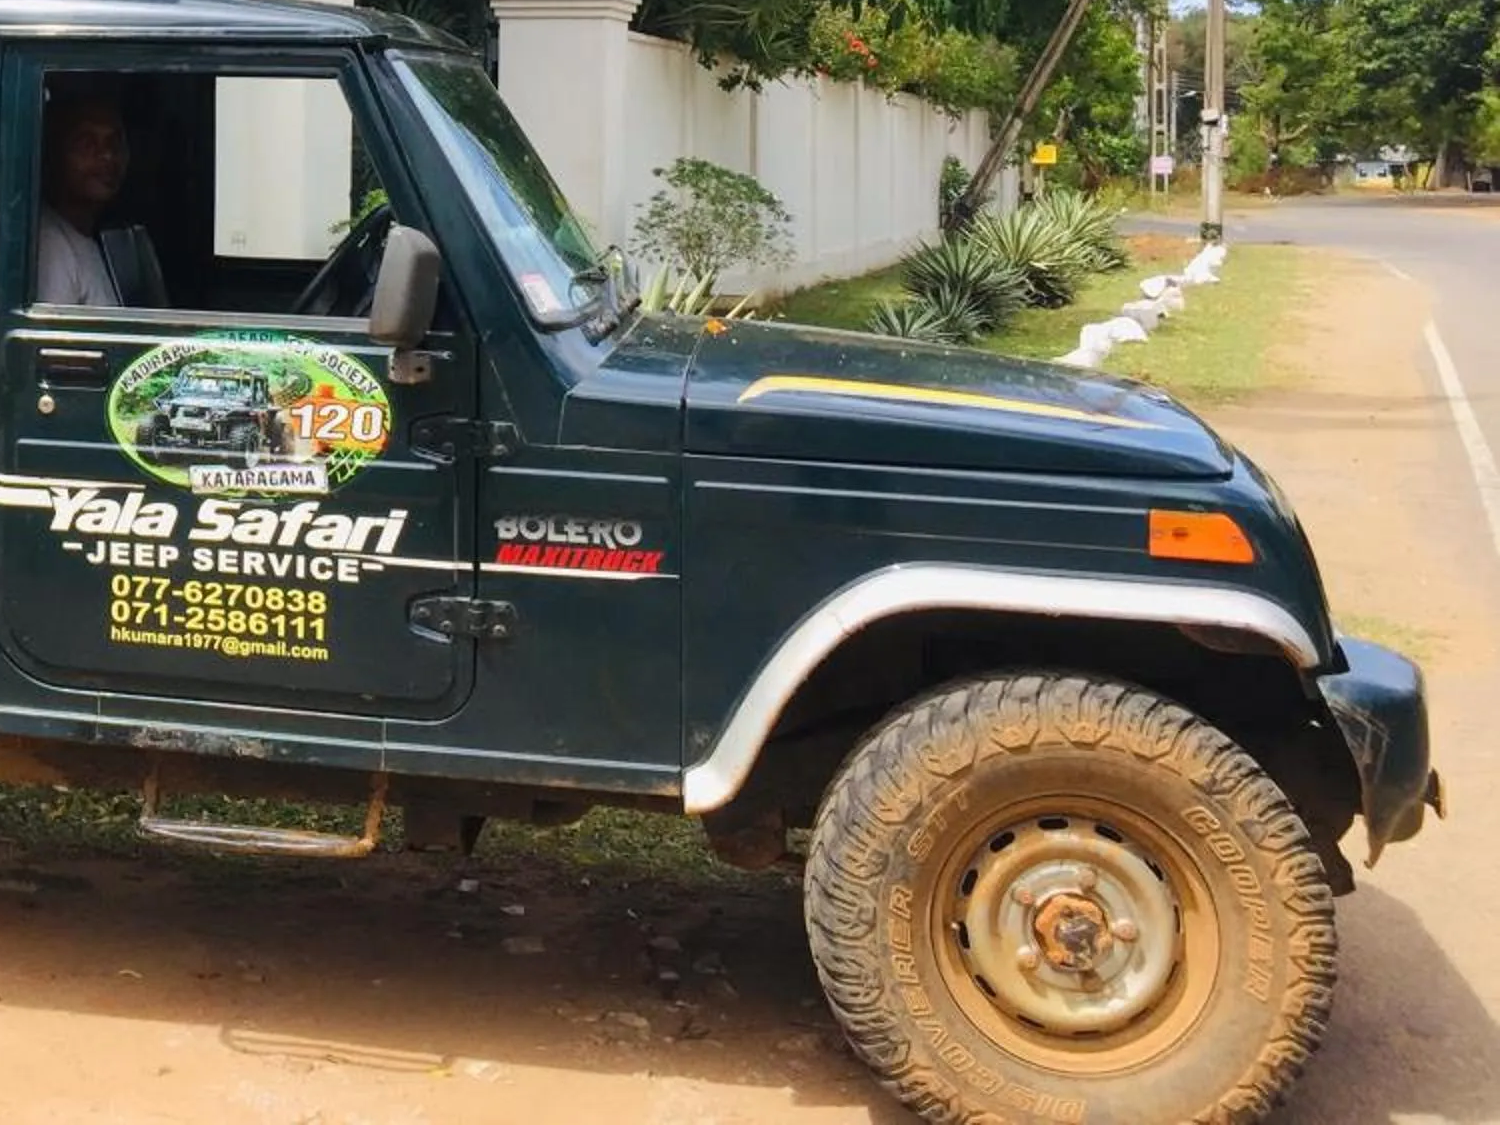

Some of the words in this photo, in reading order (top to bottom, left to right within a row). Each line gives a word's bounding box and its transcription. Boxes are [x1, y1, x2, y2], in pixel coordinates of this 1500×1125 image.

[318, 350, 380, 395] SOCIETY
[292, 403, 382, 442] 120
[202, 469, 316, 489] KATARAGAMA
[50, 487, 178, 539] Yala
[189, 499, 408, 554] Safari
[494, 515, 642, 550] BOLERO
[86, 541, 179, 569] JEEP
[192, 549, 360, 583] SERVICE
[497, 544, 663, 572] MAXITRUCK
[111, 575, 327, 614] 077-6270838
[111, 601, 326, 641] 071-2586111
[111, 627, 329, 661] hkumara1977@gmail.com
[1181, 806, 1275, 1003] COOPER
[887, 885, 1088, 1124] DISCOVERER
